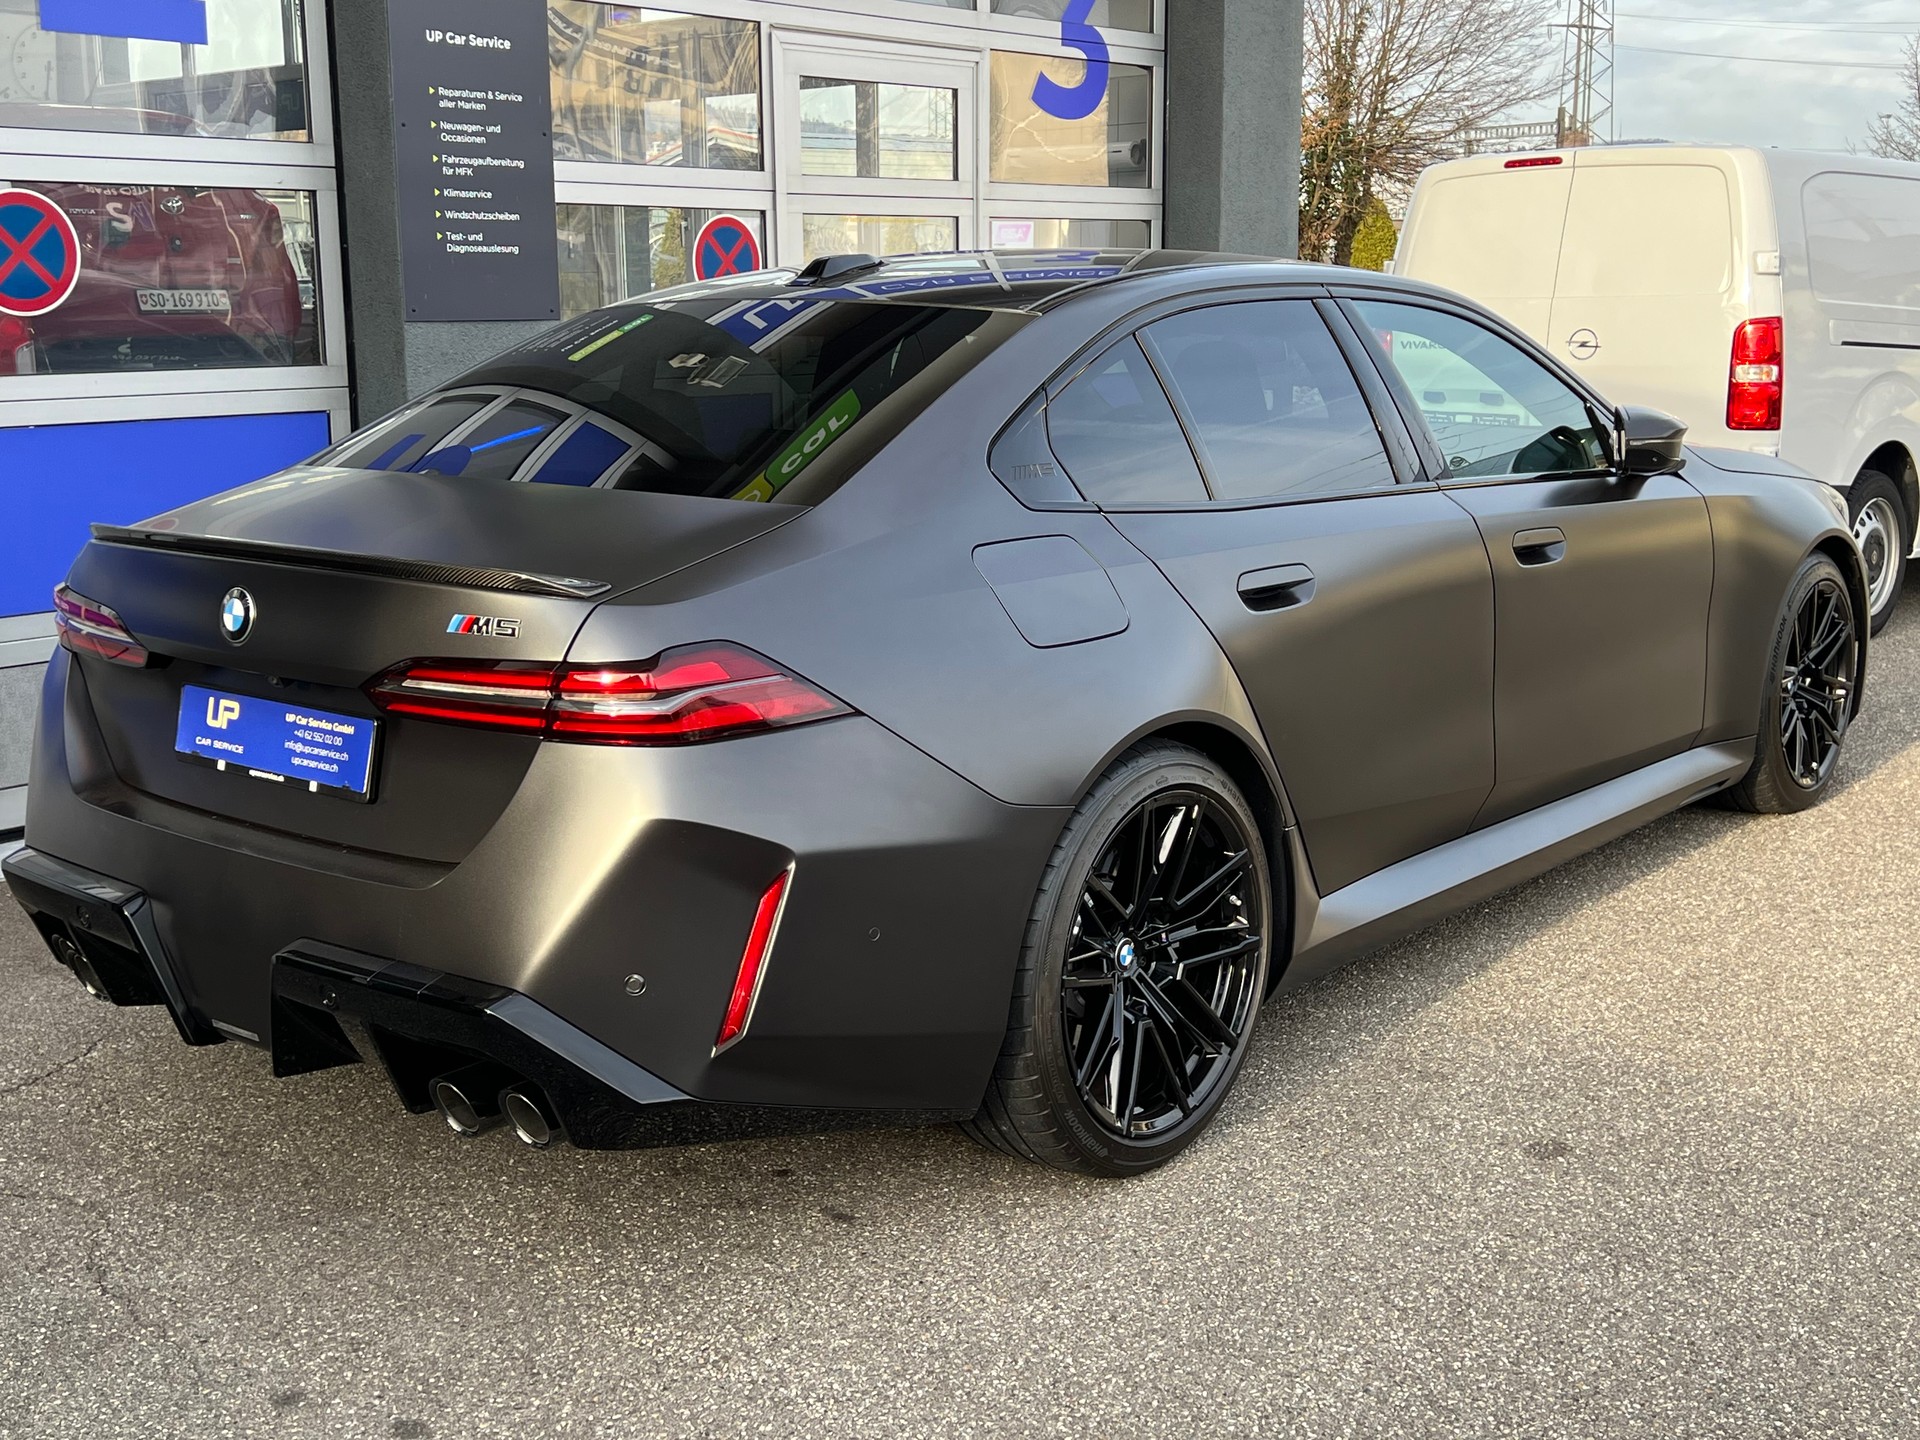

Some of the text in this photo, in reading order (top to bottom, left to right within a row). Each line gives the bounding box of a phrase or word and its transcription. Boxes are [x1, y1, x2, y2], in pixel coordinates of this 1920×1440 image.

[426, 30, 511, 50] UP Car Service
[438, 86, 523, 102] Reparaturen & Service
[438, 98, 486, 110] aller Marken
[440, 120, 501, 134] Neuwagen- und
[440, 132, 486, 144] Occasionen
[442, 154, 524, 168] Fahrzeugaufbereitung
[442, 166, 474, 176] für MFK
[444, 188, 492, 198] Klimaservice
[444, 210, 520, 221] Windschutzscheiben
[446, 232, 483, 241] Test- und
[446, 243, 519, 254] Diagnoseauslesung
[464, 614, 522, 639] M5
[206, 696, 240, 730] UP
[285, 712, 354, 734] UP Car Service GmbH
[196, 736, 244, 754] CAR SERVICE
[304, 730, 312, 740] 62
[324, 734, 333, 744] 02
[334, 736, 342, 746] 00
[284, 740, 348, 761] info@upcarservice.ch
[291, 756, 338, 773] upcarservice.ch
